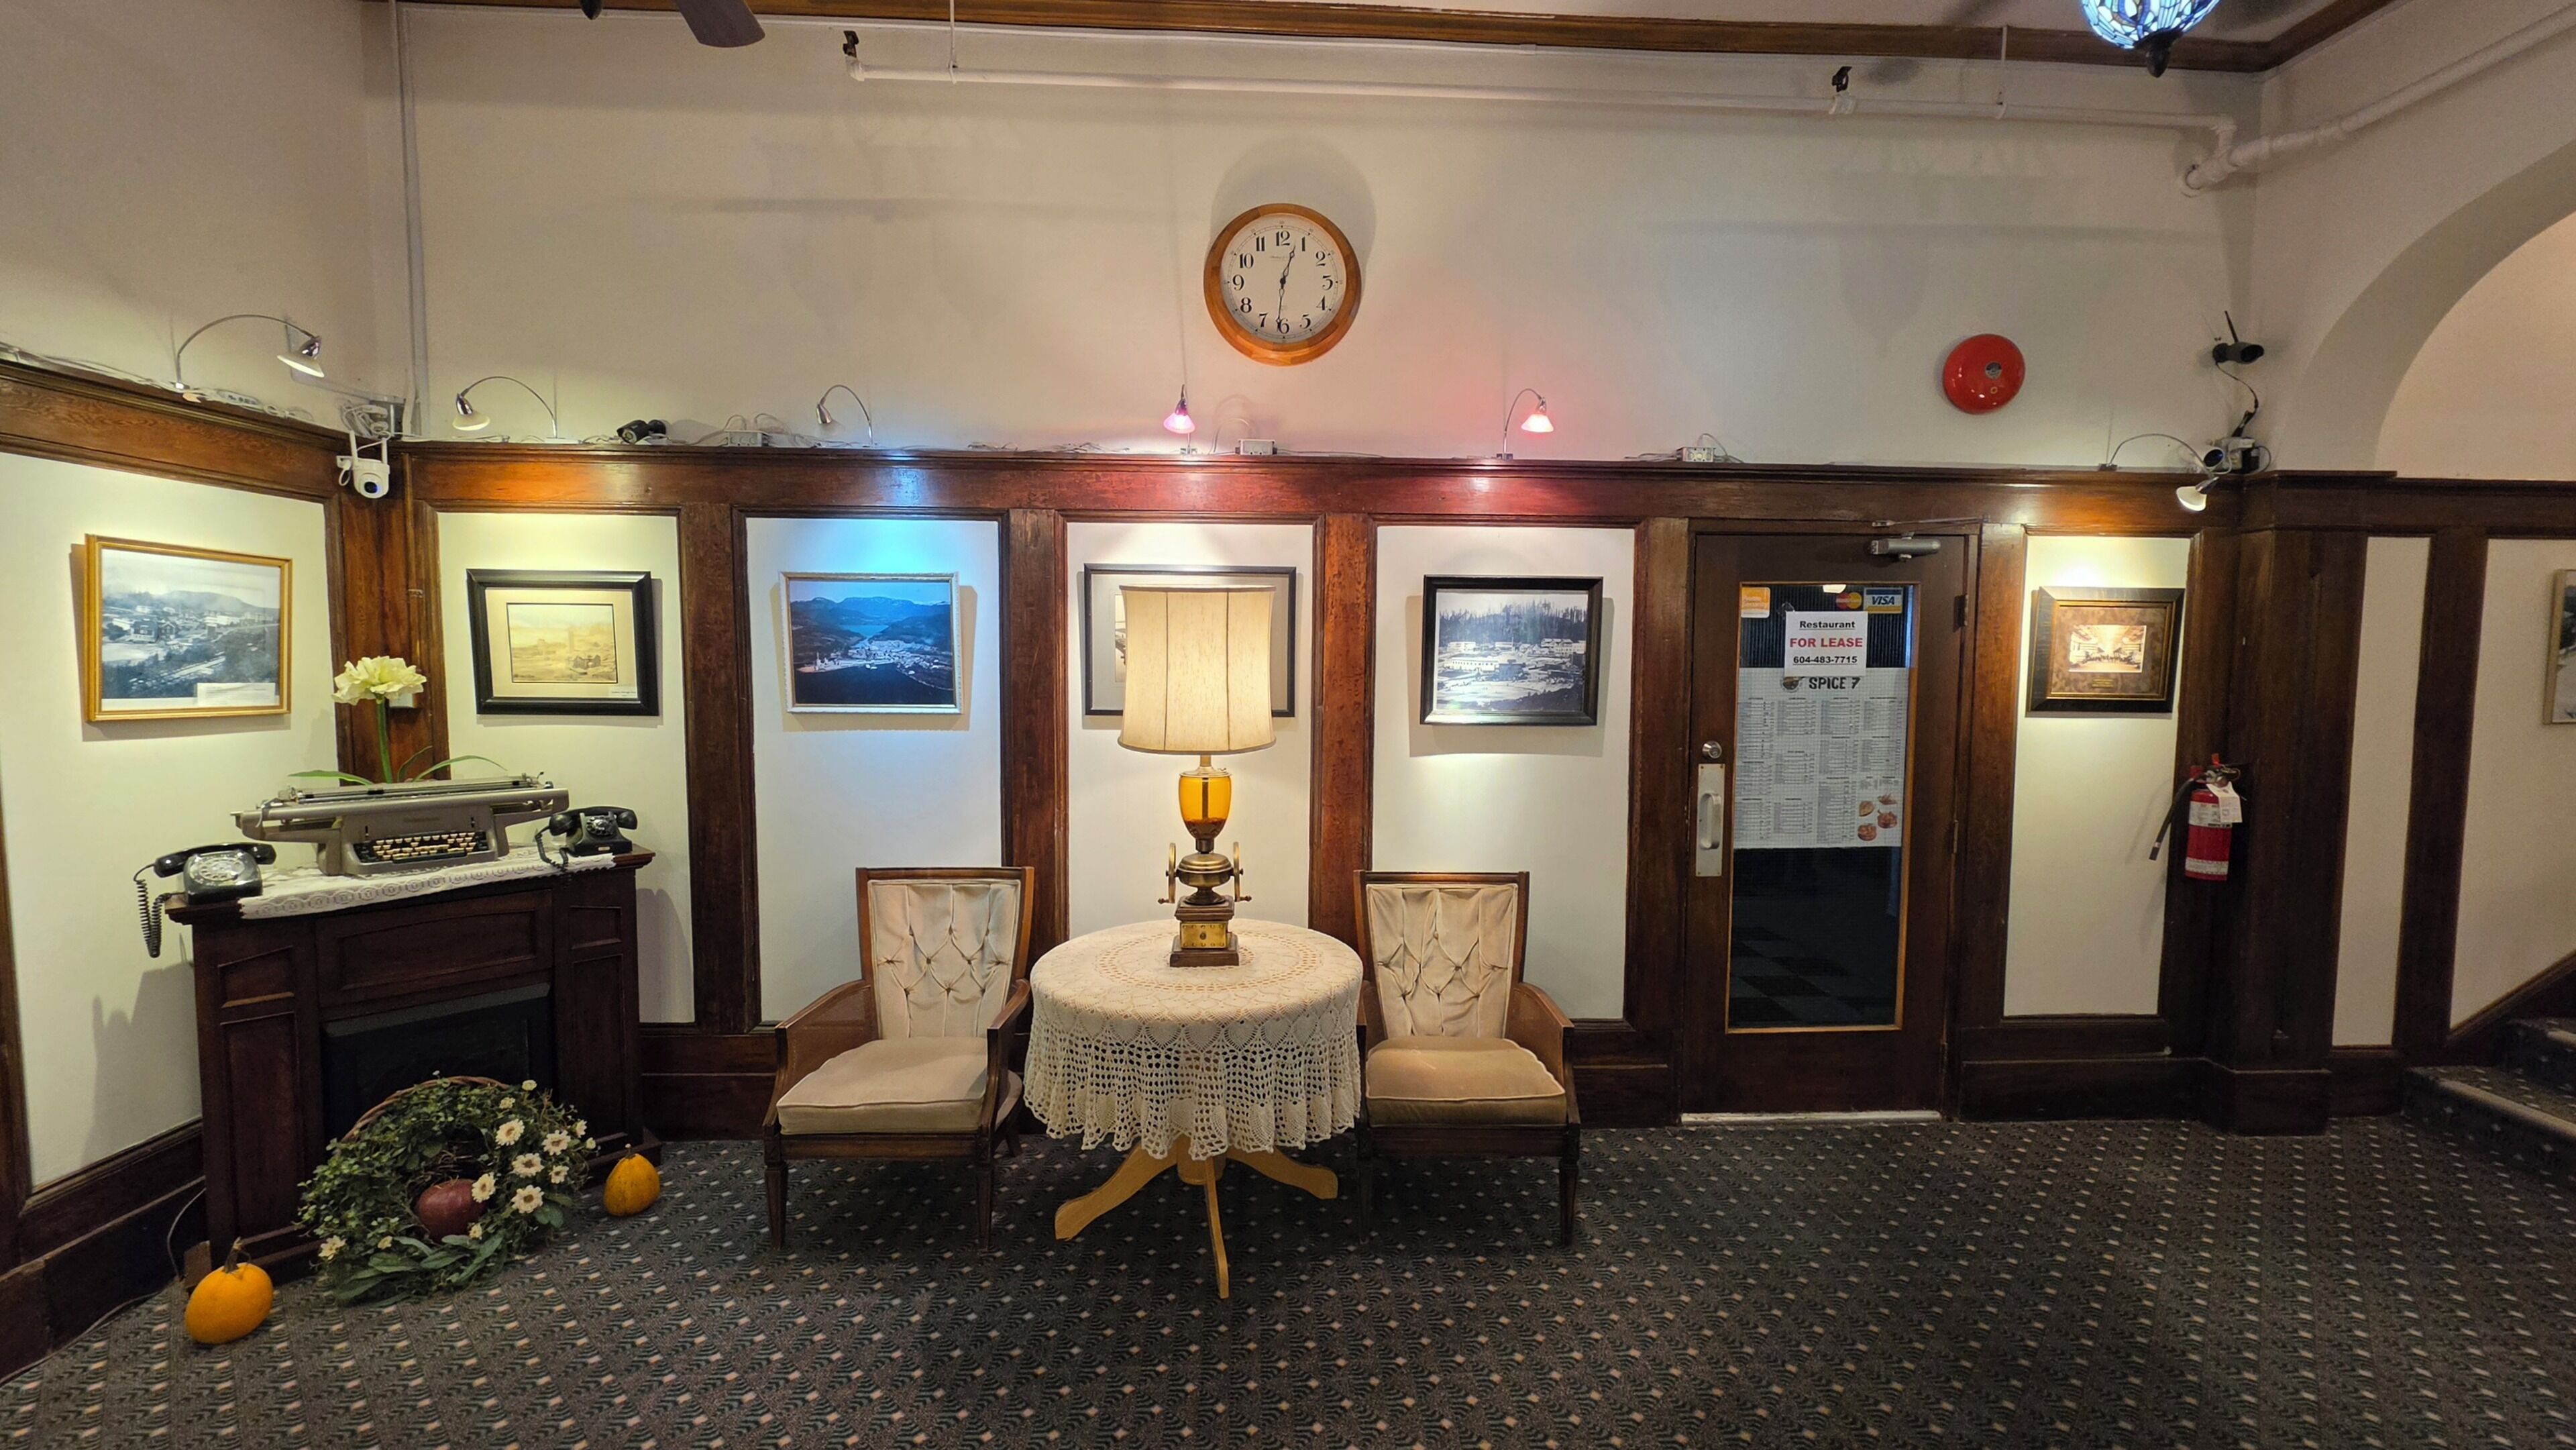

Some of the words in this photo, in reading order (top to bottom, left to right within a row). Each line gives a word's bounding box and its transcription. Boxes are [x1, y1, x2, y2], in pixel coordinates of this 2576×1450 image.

[1256, 236, 1265, 252] 11
[1276, 230, 1290, 246] 12
[1301, 236, 1305, 252] 1
[1240, 253, 1254, 268] 10
[1316, 251, 1326, 266] 2
[1232, 274, 1244, 291] 9
[1240, 297, 1252, 313] 8
[1316, 295, 1328, 311] 4
[1259, 313, 1268, 327] 7
[1279, 318, 1289, 334] 6
[1300, 314, 1311, 329] 5
[1872, 596, 1895, 605] VISA
[1790, 638, 1816, 648] FOR
[1821, 638, 1863, 648] LEASE
[1809, 676, 1846, 690] SPICE
[1851, 677, 1861, 690] 7
